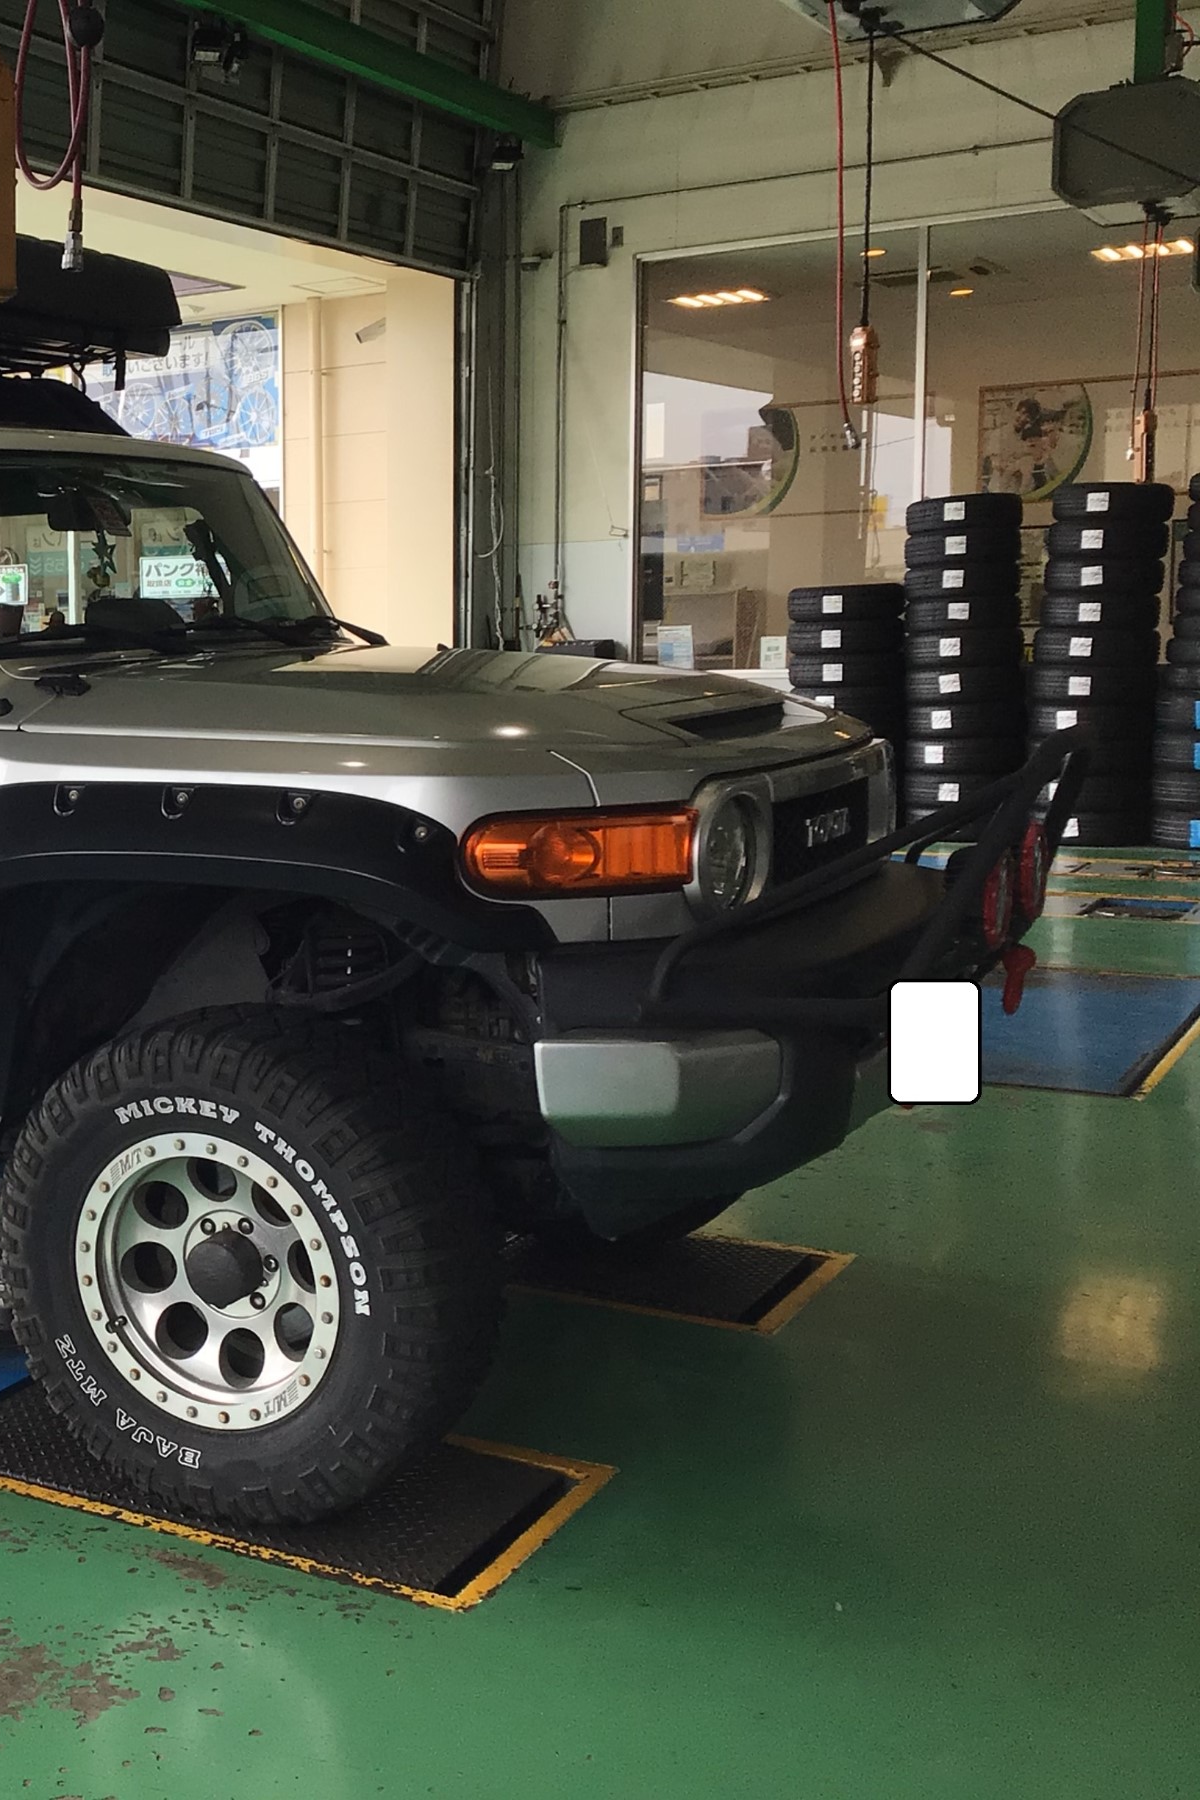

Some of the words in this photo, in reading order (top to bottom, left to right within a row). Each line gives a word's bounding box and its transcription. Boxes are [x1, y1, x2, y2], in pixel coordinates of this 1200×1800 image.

[115, 1096, 240, 1125] MICKEY
[254, 1121, 372, 1317] THOMPSON
[54, 1334, 107, 1406] MTZ
[115, 1407, 202, 1469] BAJA
